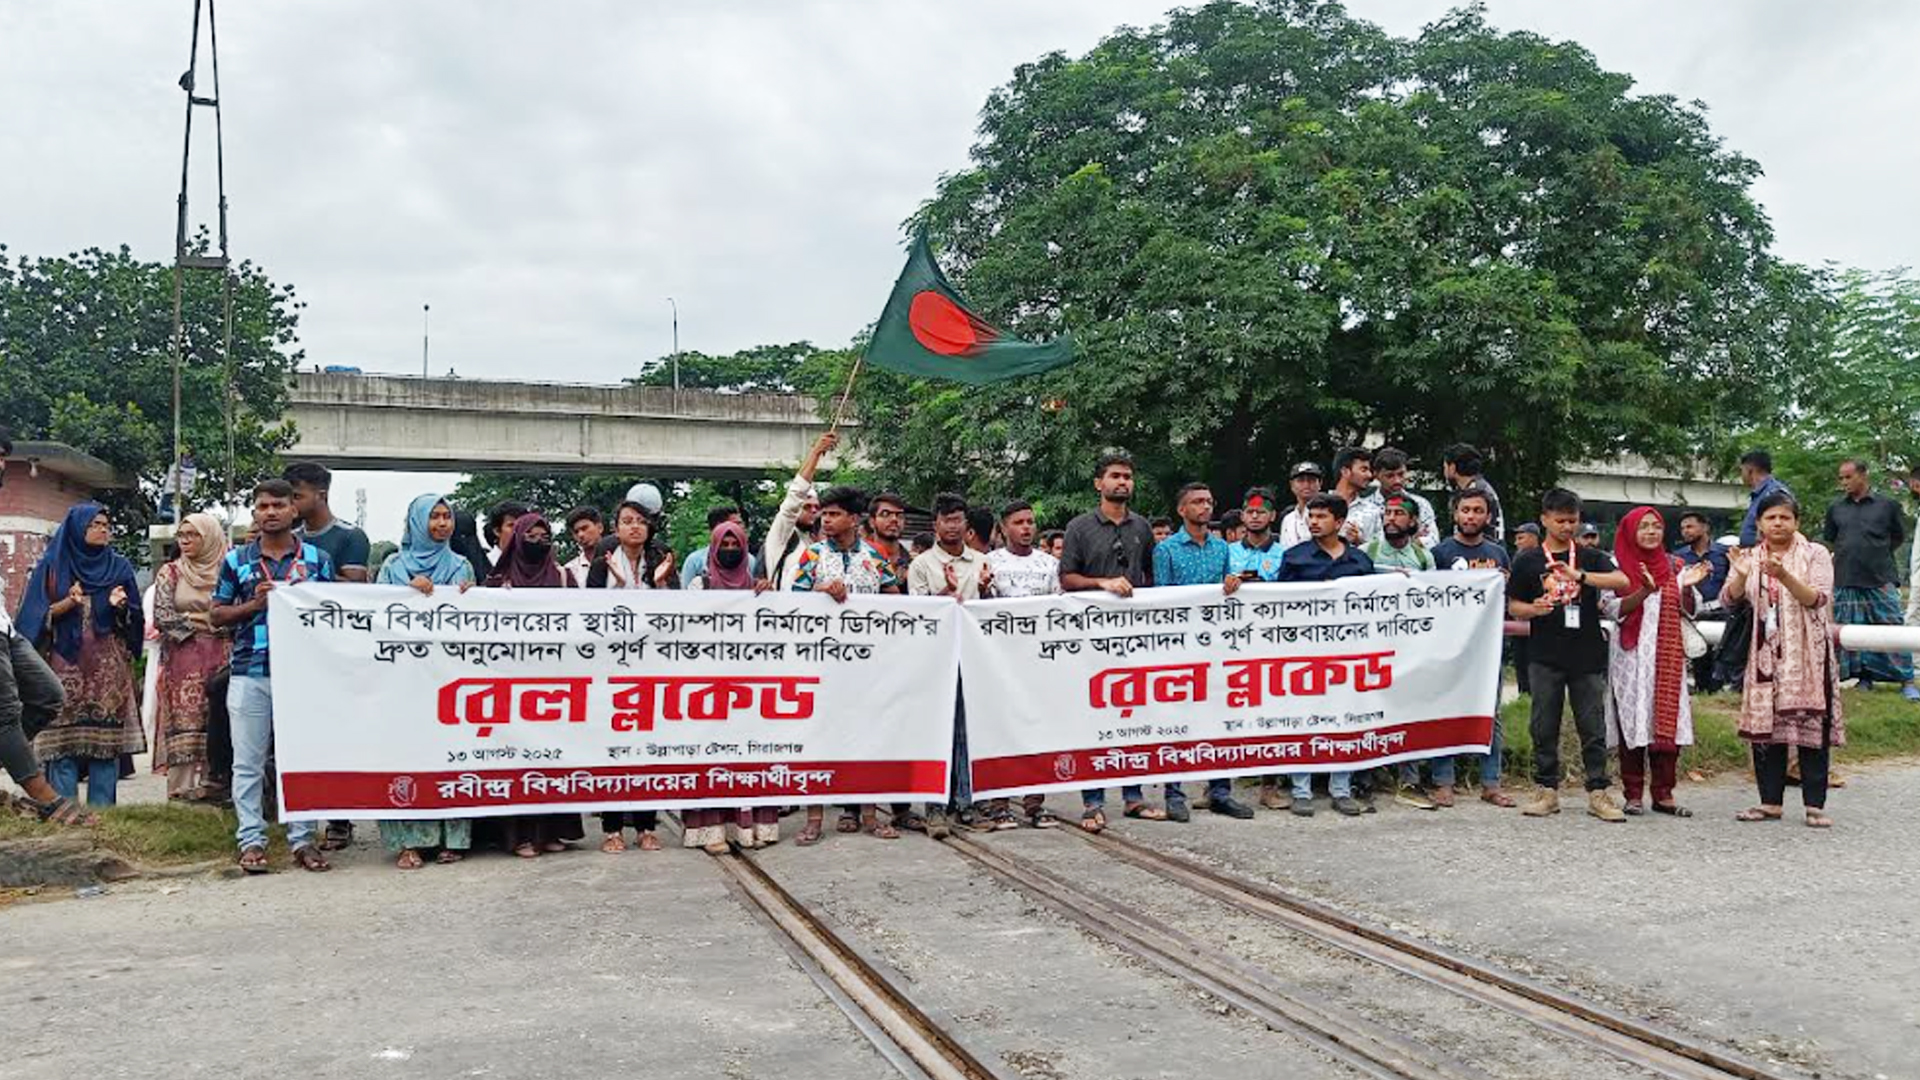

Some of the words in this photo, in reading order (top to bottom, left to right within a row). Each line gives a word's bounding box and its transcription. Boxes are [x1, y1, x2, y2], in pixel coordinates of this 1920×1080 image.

[298, 600, 375, 631] রবীন্দ্র
[386, 603, 571, 633] বিশ্ববিদ্যালয়ের
[579, 606, 637, 637] স্থায়ী
[648, 612, 746, 633] ক্যাম্পাস
[754, 609, 832, 635] নির্মাণে
[979, 611, 1039, 635] রবীন্দ্র
[1045, 605, 1192, 633] বিশ্ববিদ্যালয়ের
[1199, 597, 1245, 625] স্থায়ী
[1252, 597, 1338, 620] ক্যাম্পাস
[1343, 589, 1400, 616] নির্মাণে
[374, 640, 433, 663] দ্রুত
[441, 641, 566, 666] অনুমোদন
[576, 645, 596, 659] ও
[607, 636, 650, 667] পূর্ণ
[655, 641, 787, 662] বাস্তবায়নের
[796, 637, 874, 662] দাবিতে
[1038, 638, 1084, 660] দ্রুত
[1090, 631, 1187, 657] অনুমোদন
[1196, 634, 1212, 647] ও
[1221, 622, 1255, 651] পূর্ণ
[1260, 621, 1370, 646] বাস্তবায়নের
[1376, 613, 1435, 638] দাবিতে
[1089, 662, 1211, 718] রেল
[1223, 651, 1396, 708] ব্লকেড
[437, 677, 592, 737] রেল
[608, 676, 820, 732] ব্লকেড
[447, 750, 468, 763] ১৩
[472, 745, 518, 761] আগস্ট
[522, 748, 563, 761] ২০২৫
[1090, 748, 1151, 771] রবীন্দ্র
[1157, 742, 1304, 767] বিশ্ববিদ্যালয়ের
[1309, 730, 1407, 757] শিক্ষার্থীবৃন্দ
[1098, 730, 1114, 741] ১৩
[436, 772, 513, 799] রবীন্দ্র
[522, 769, 699, 796] বিশ্ববিদ্যালয়ের
[706, 764, 835, 795] শিক্ষার্থীবৃন্দ
